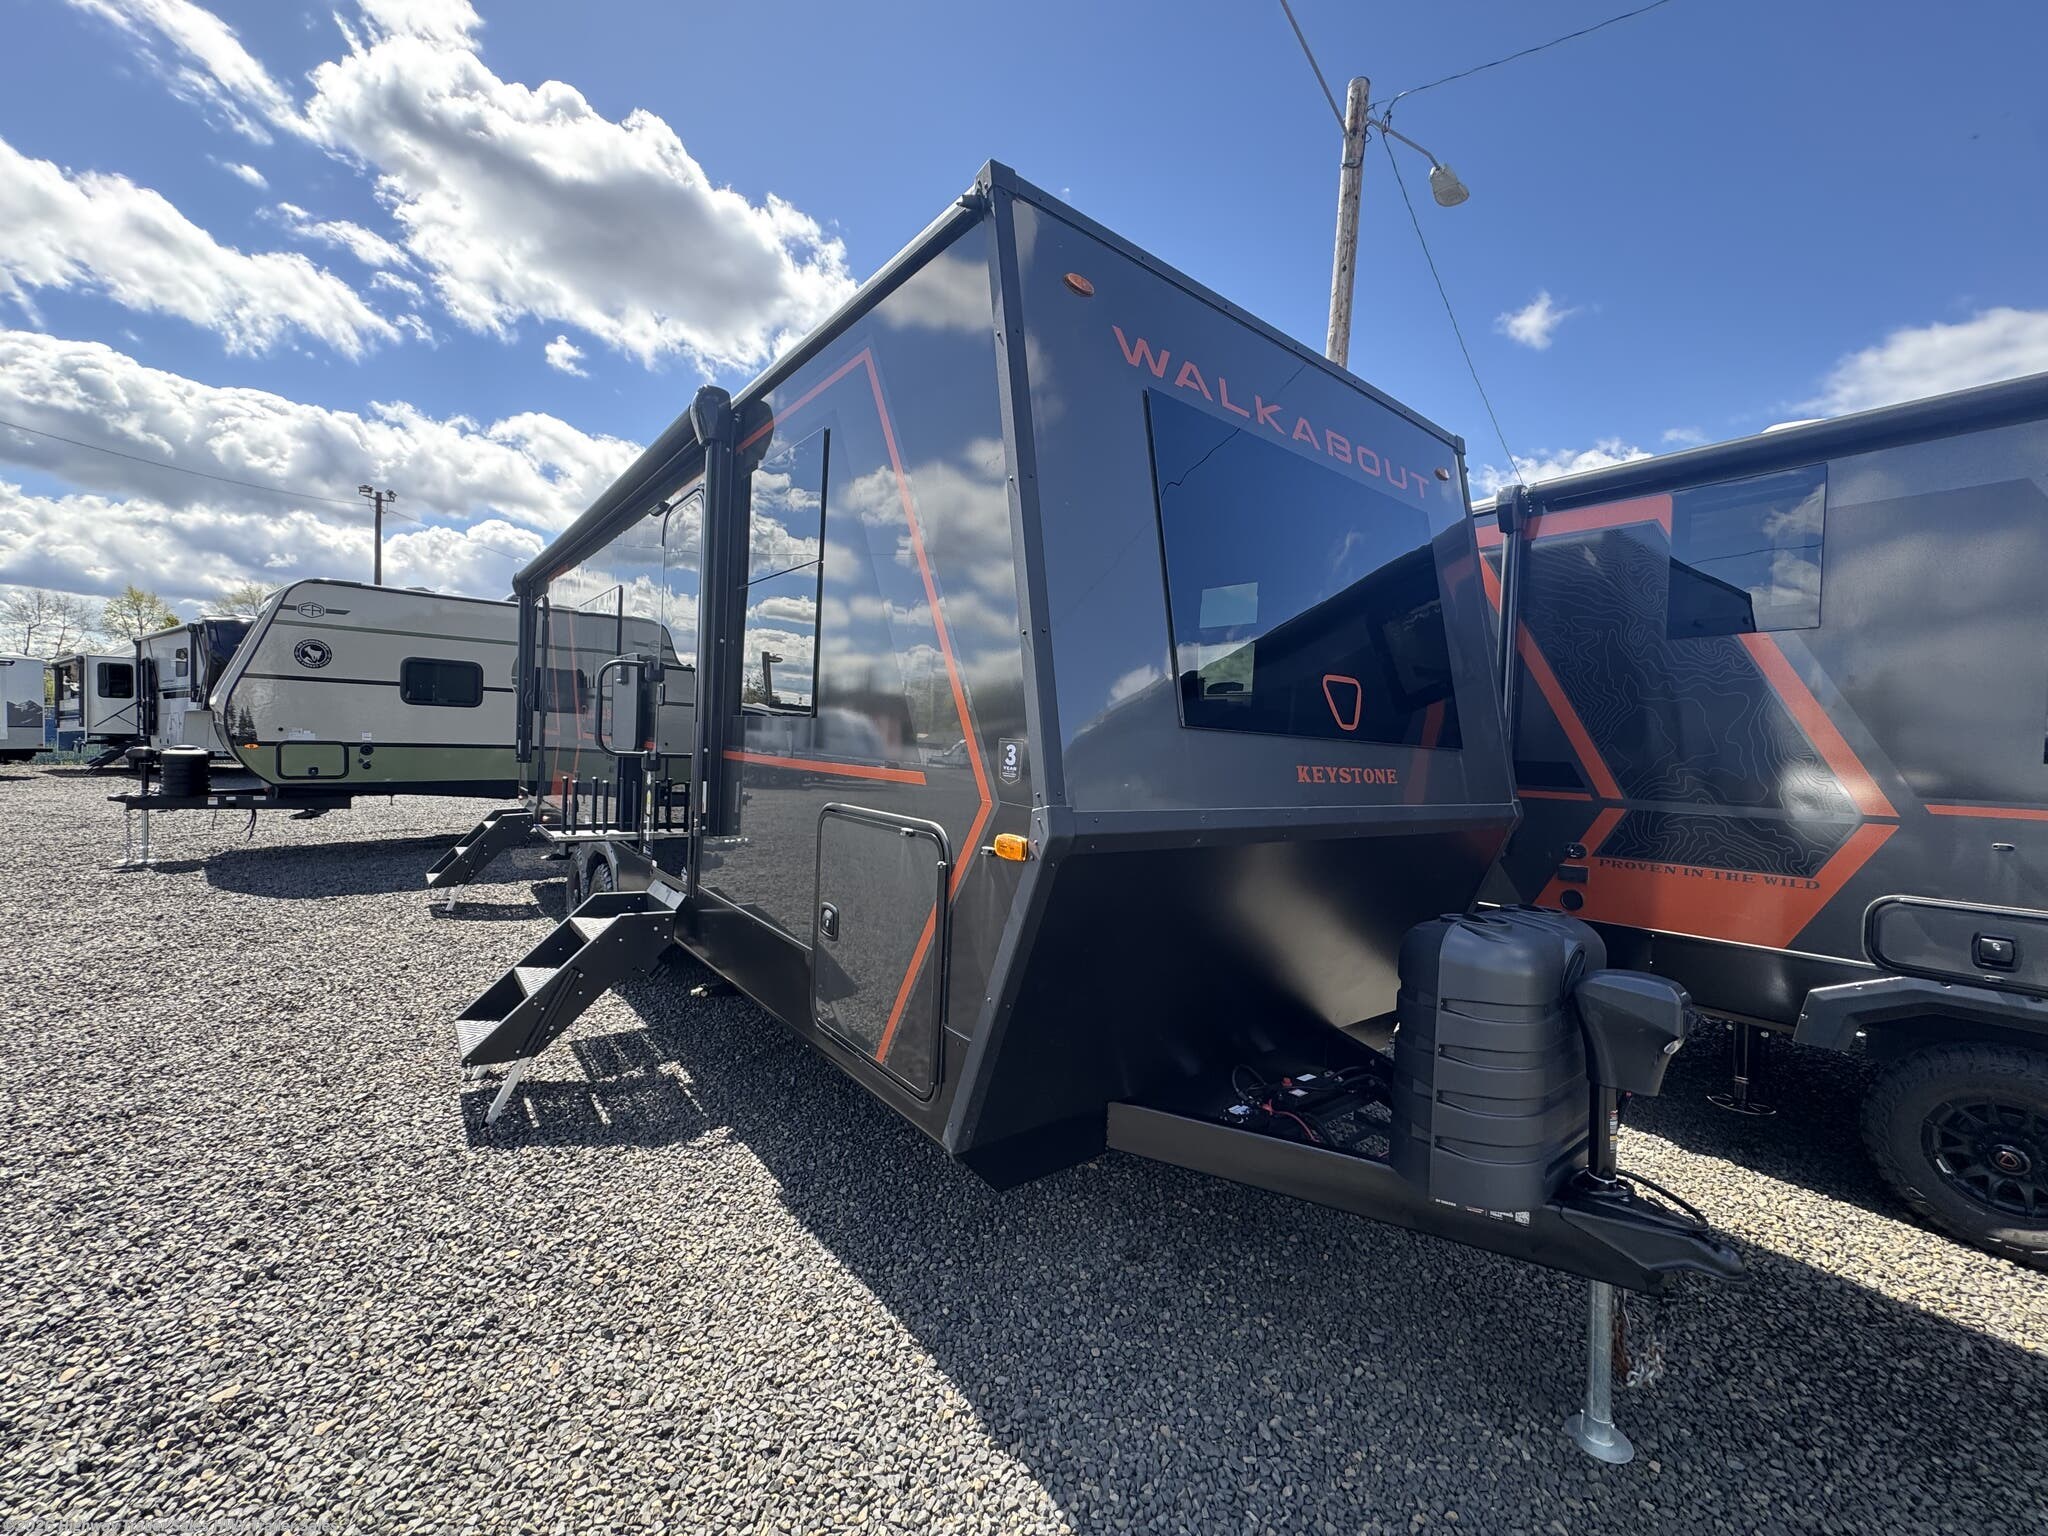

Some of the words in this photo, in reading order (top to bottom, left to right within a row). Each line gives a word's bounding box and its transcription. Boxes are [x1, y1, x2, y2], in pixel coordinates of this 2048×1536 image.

[1112, 325, 1429, 498] WALKABOUT
[1005, 744, 1016, 766] 3
[1296, 765, 1398, 784] KEYSTONE
[1599, 859, 1676, 874] PROVEN
[1683, 867, 1704, 877] IN
[1712, 870, 1756, 883] THE
[1764, 876, 1821, 890] WILD
